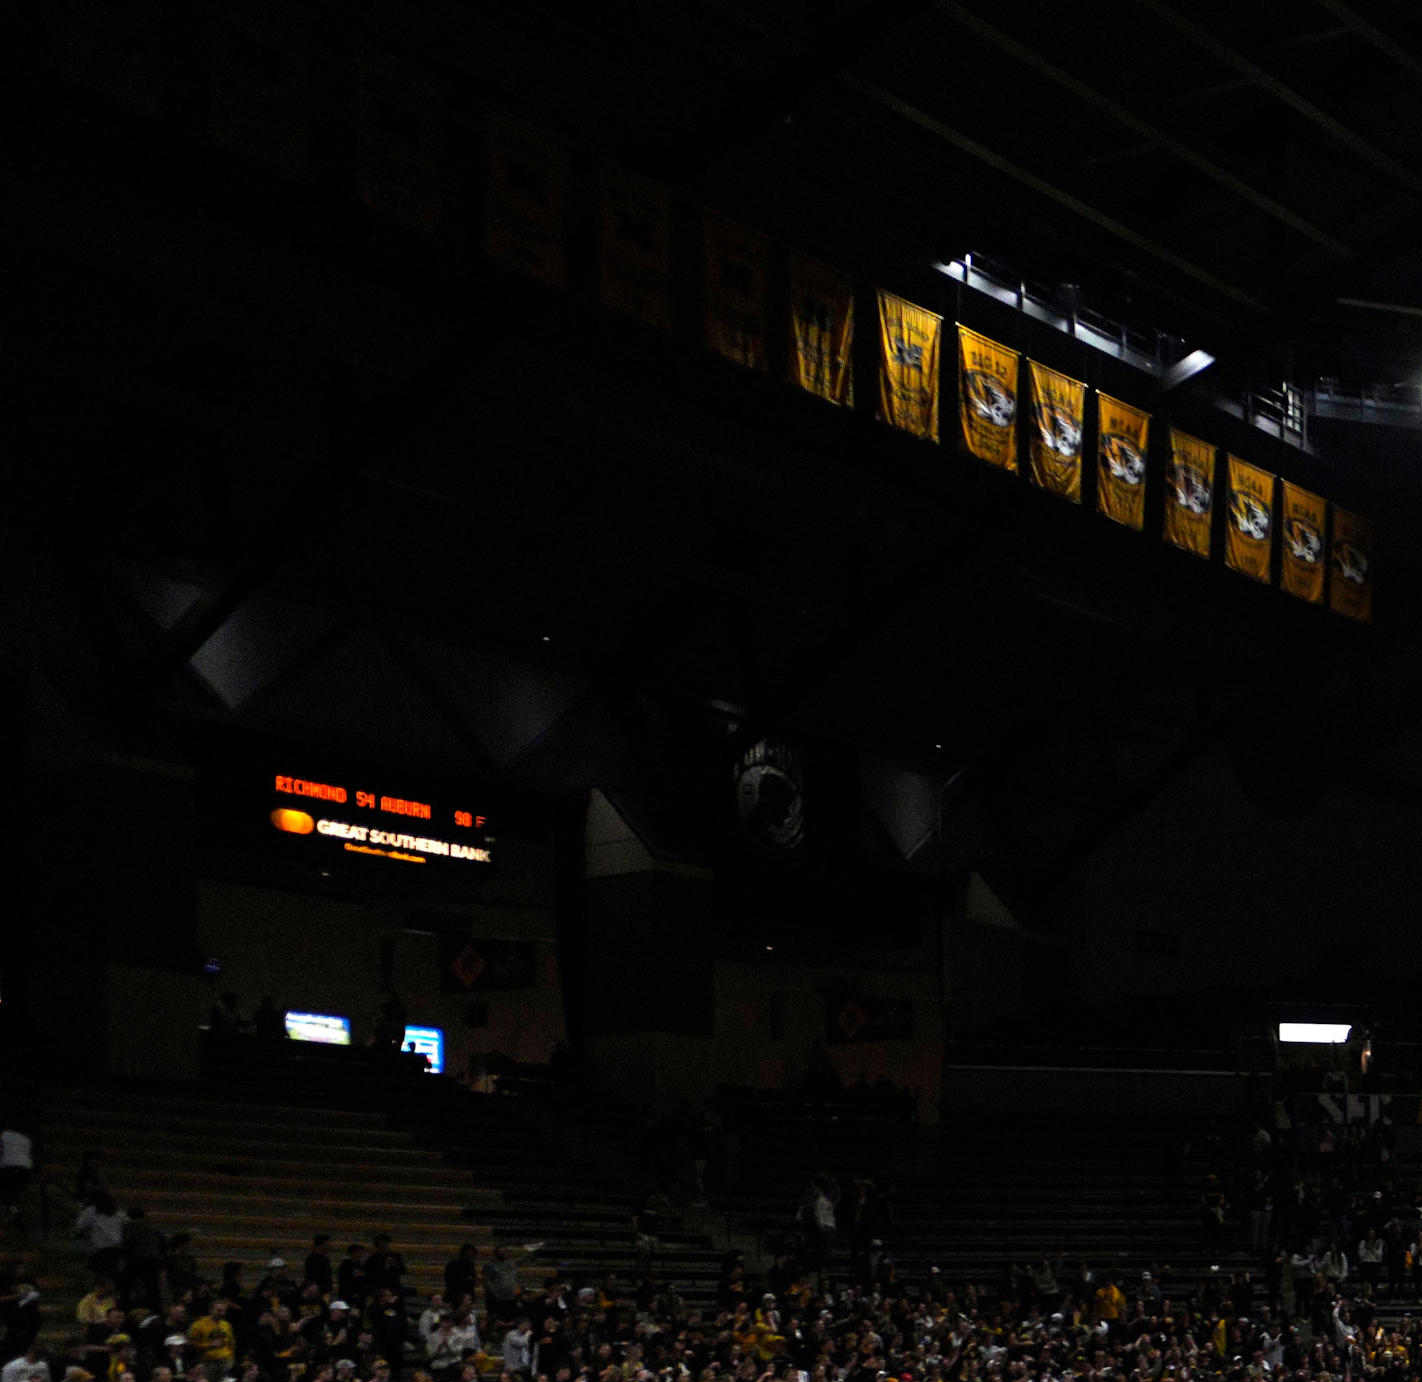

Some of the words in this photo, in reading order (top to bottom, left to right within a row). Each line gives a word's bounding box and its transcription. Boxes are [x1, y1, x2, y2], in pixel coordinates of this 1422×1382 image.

[275, 775, 347, 803] RICHMOND
[356, 791, 375, 809] 54
[380, 796, 431, 820] AUBURN
[316, 819, 369, 841] GREAT
[369, 828, 449, 856] SOUTHERN
[450, 843, 491, 862] BANK
